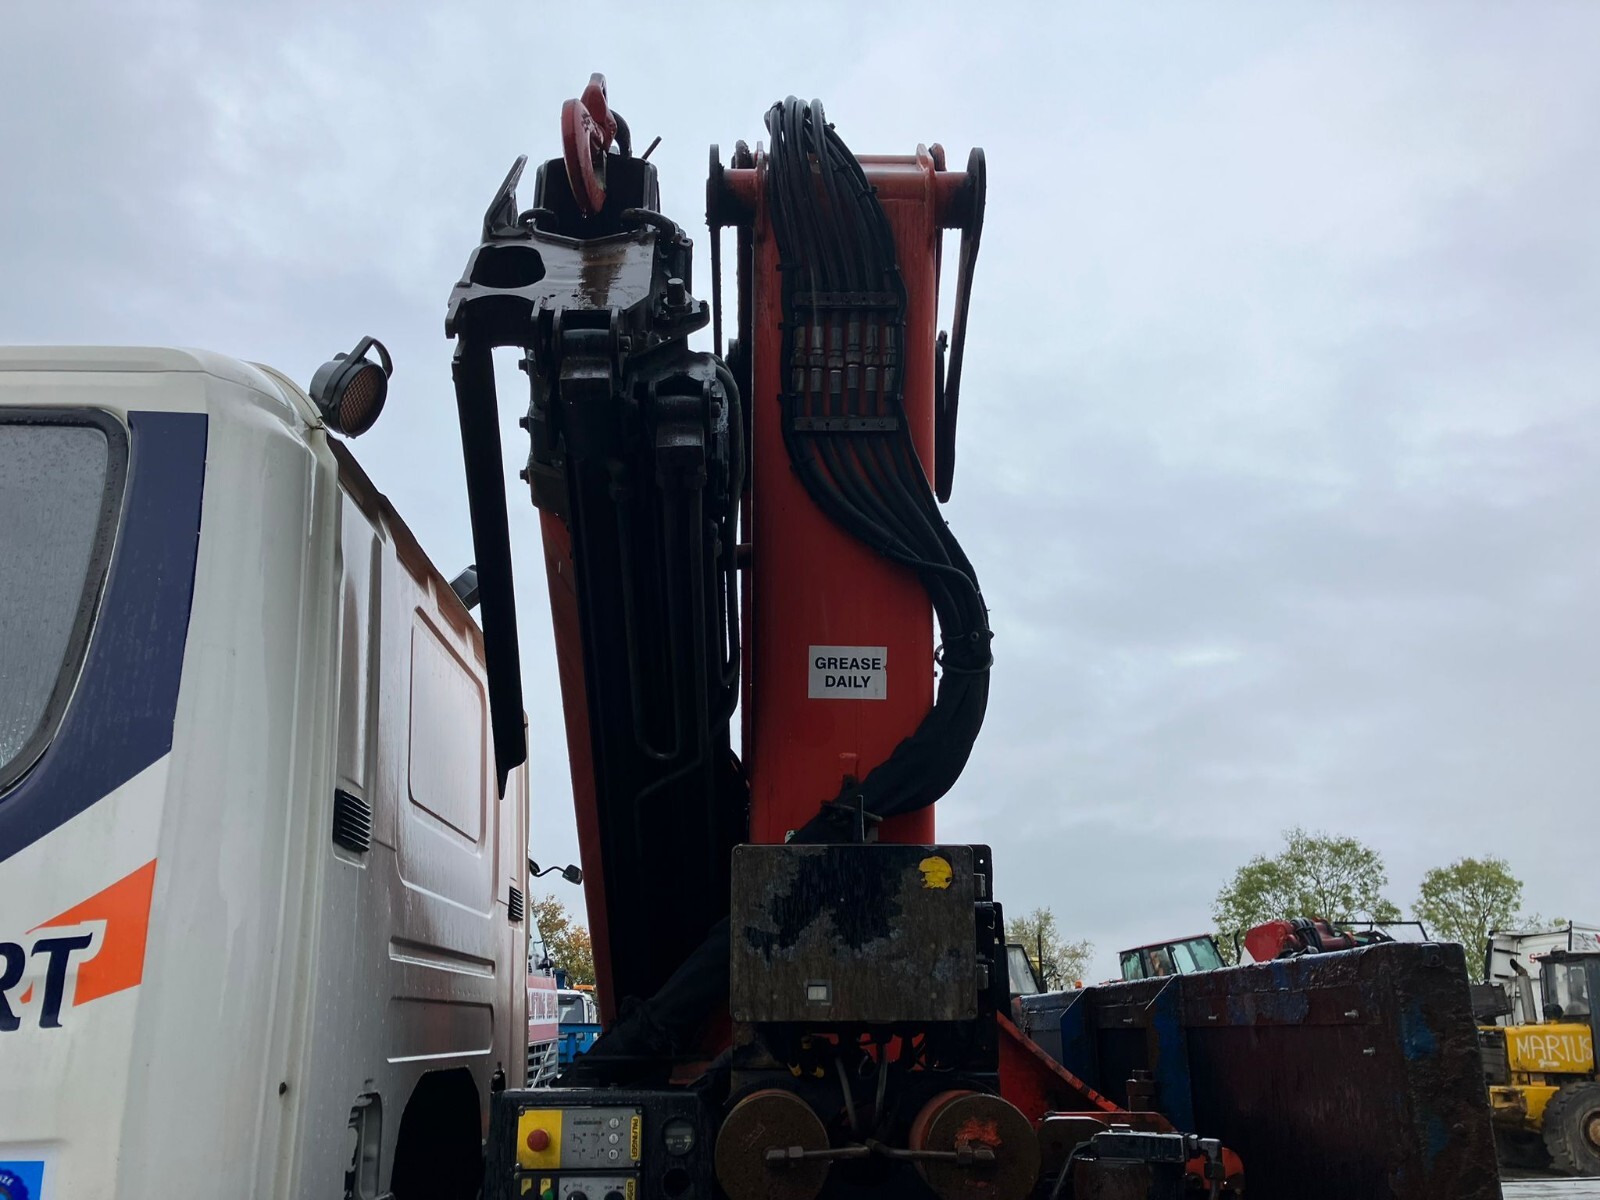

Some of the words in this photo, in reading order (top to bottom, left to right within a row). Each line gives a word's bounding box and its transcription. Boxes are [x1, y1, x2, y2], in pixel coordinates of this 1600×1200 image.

[815, 657, 881, 670] GREASE
[825, 675, 871, 688] DAILY
[1516, 1034, 1593, 1063] MARIUS
